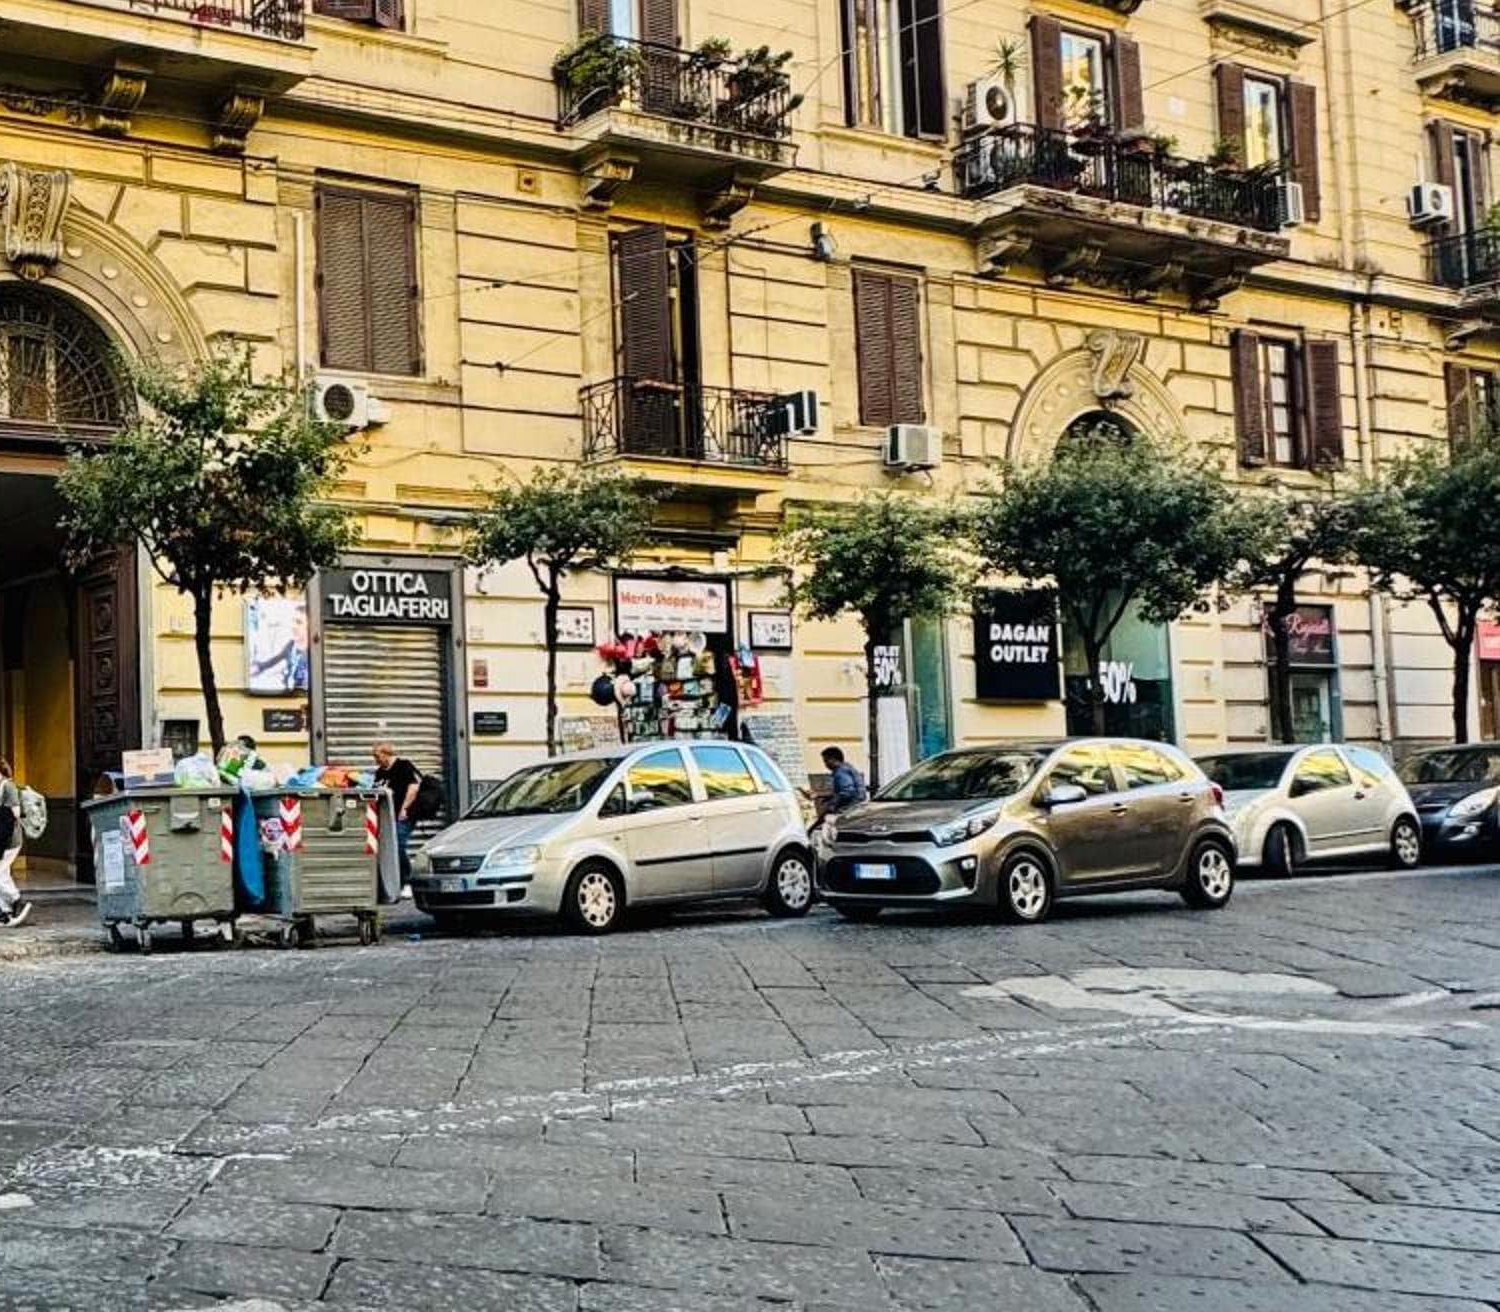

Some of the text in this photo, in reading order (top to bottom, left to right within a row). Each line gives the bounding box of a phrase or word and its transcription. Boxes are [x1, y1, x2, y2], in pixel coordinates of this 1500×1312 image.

[351, 570, 428, 594] OTTICA
[329, 593, 449, 619] TAGLIAFERRI
[990, 623, 1050, 643] DAGAN
[990, 645, 1049, 663] OUTLET
